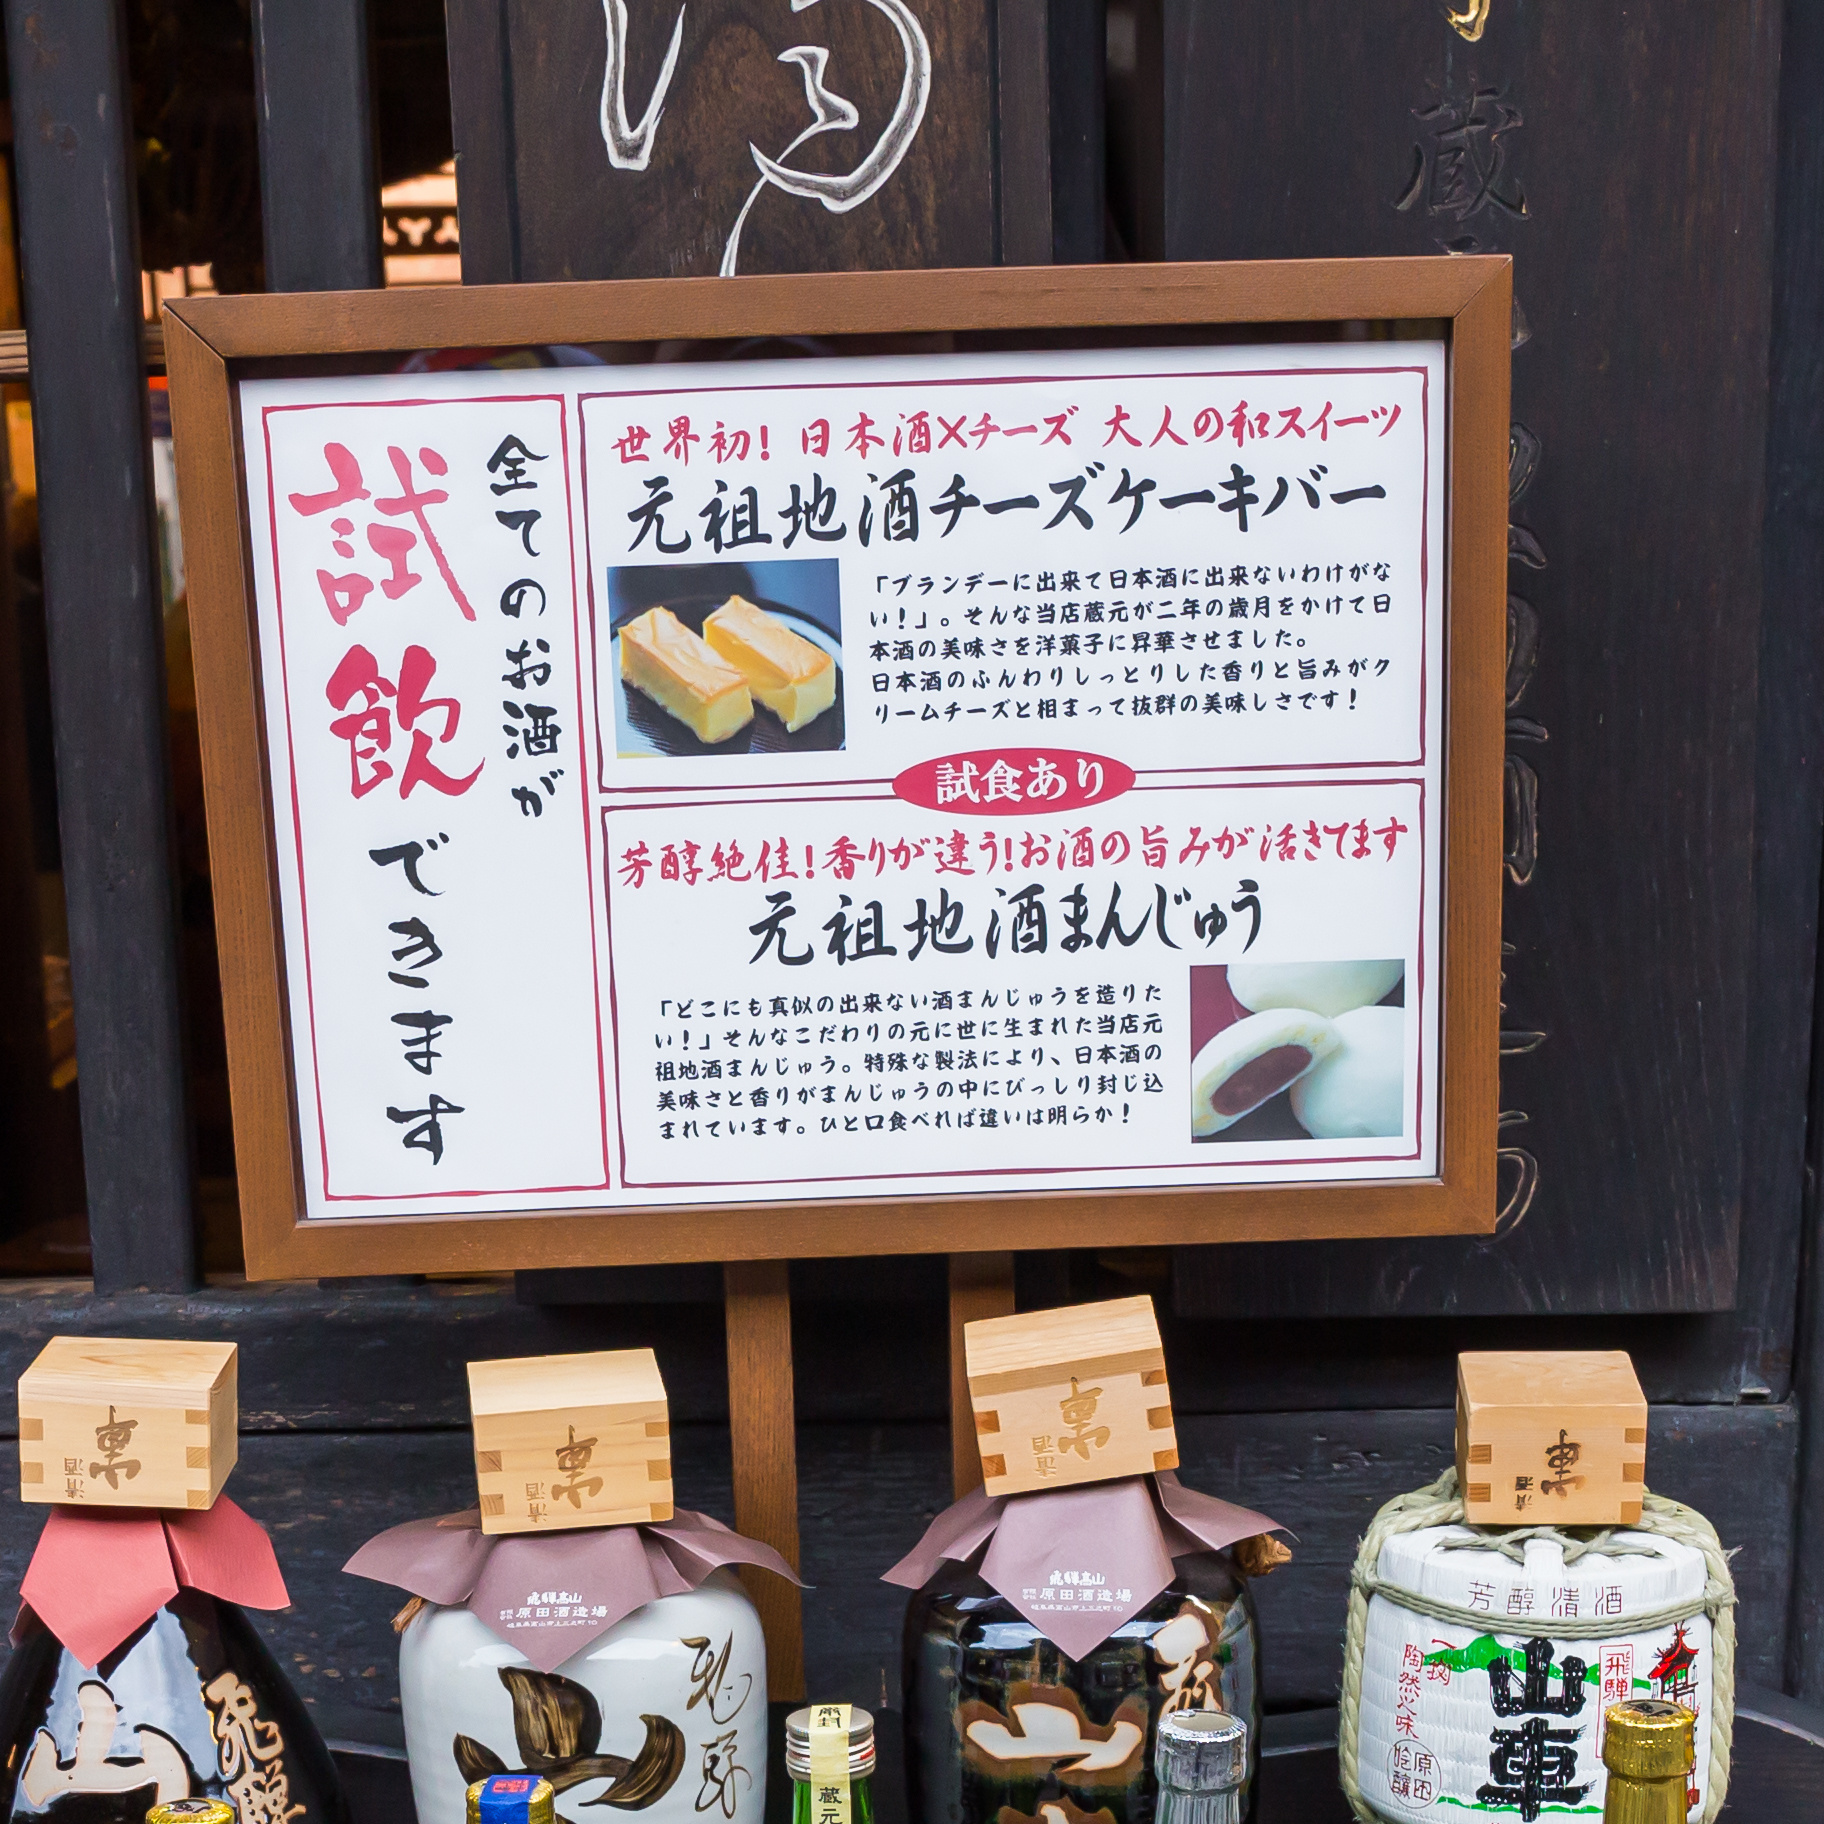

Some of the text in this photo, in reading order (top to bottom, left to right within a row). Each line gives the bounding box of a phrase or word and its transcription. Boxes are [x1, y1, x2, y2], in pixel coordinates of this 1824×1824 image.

[1105, 402, 1403, 449] 大人の和スイーツ
[627, 461, 1387, 554] 元祖地酒チーズケーキバー
[875, 561, 1392, 597] 「ブランデーに出来て日本酒に出来ないわけがな
[487, 434, 564, 818] 全てのお酒が
[869, 629, 1307, 662] 本酒の美味さを洋菓子に昇華させました。
[871, 658, 1392, 693] 日本酒のふんわりしっとりした香りと旨みがク
[936, 757, 1106, 806] 試食あり
[288, 442, 485, 1166] 試飲できます
[748, 878, 1267, 967] 元祖地酒まんじゅう
[661, 984, 1162, 1020] 「どこにも真似の出来ない酒まんじゅうを造りた
[654, 1044, 1162, 1082] 祖地酒まんじゅう。特殊な製法により、日本酒の
[656, 1073, 1164, 1112] 美味さと香りがまんじゅうの中にびっしり封じ込
[1467, 1581, 1624, 1618] 芳醇清酒
